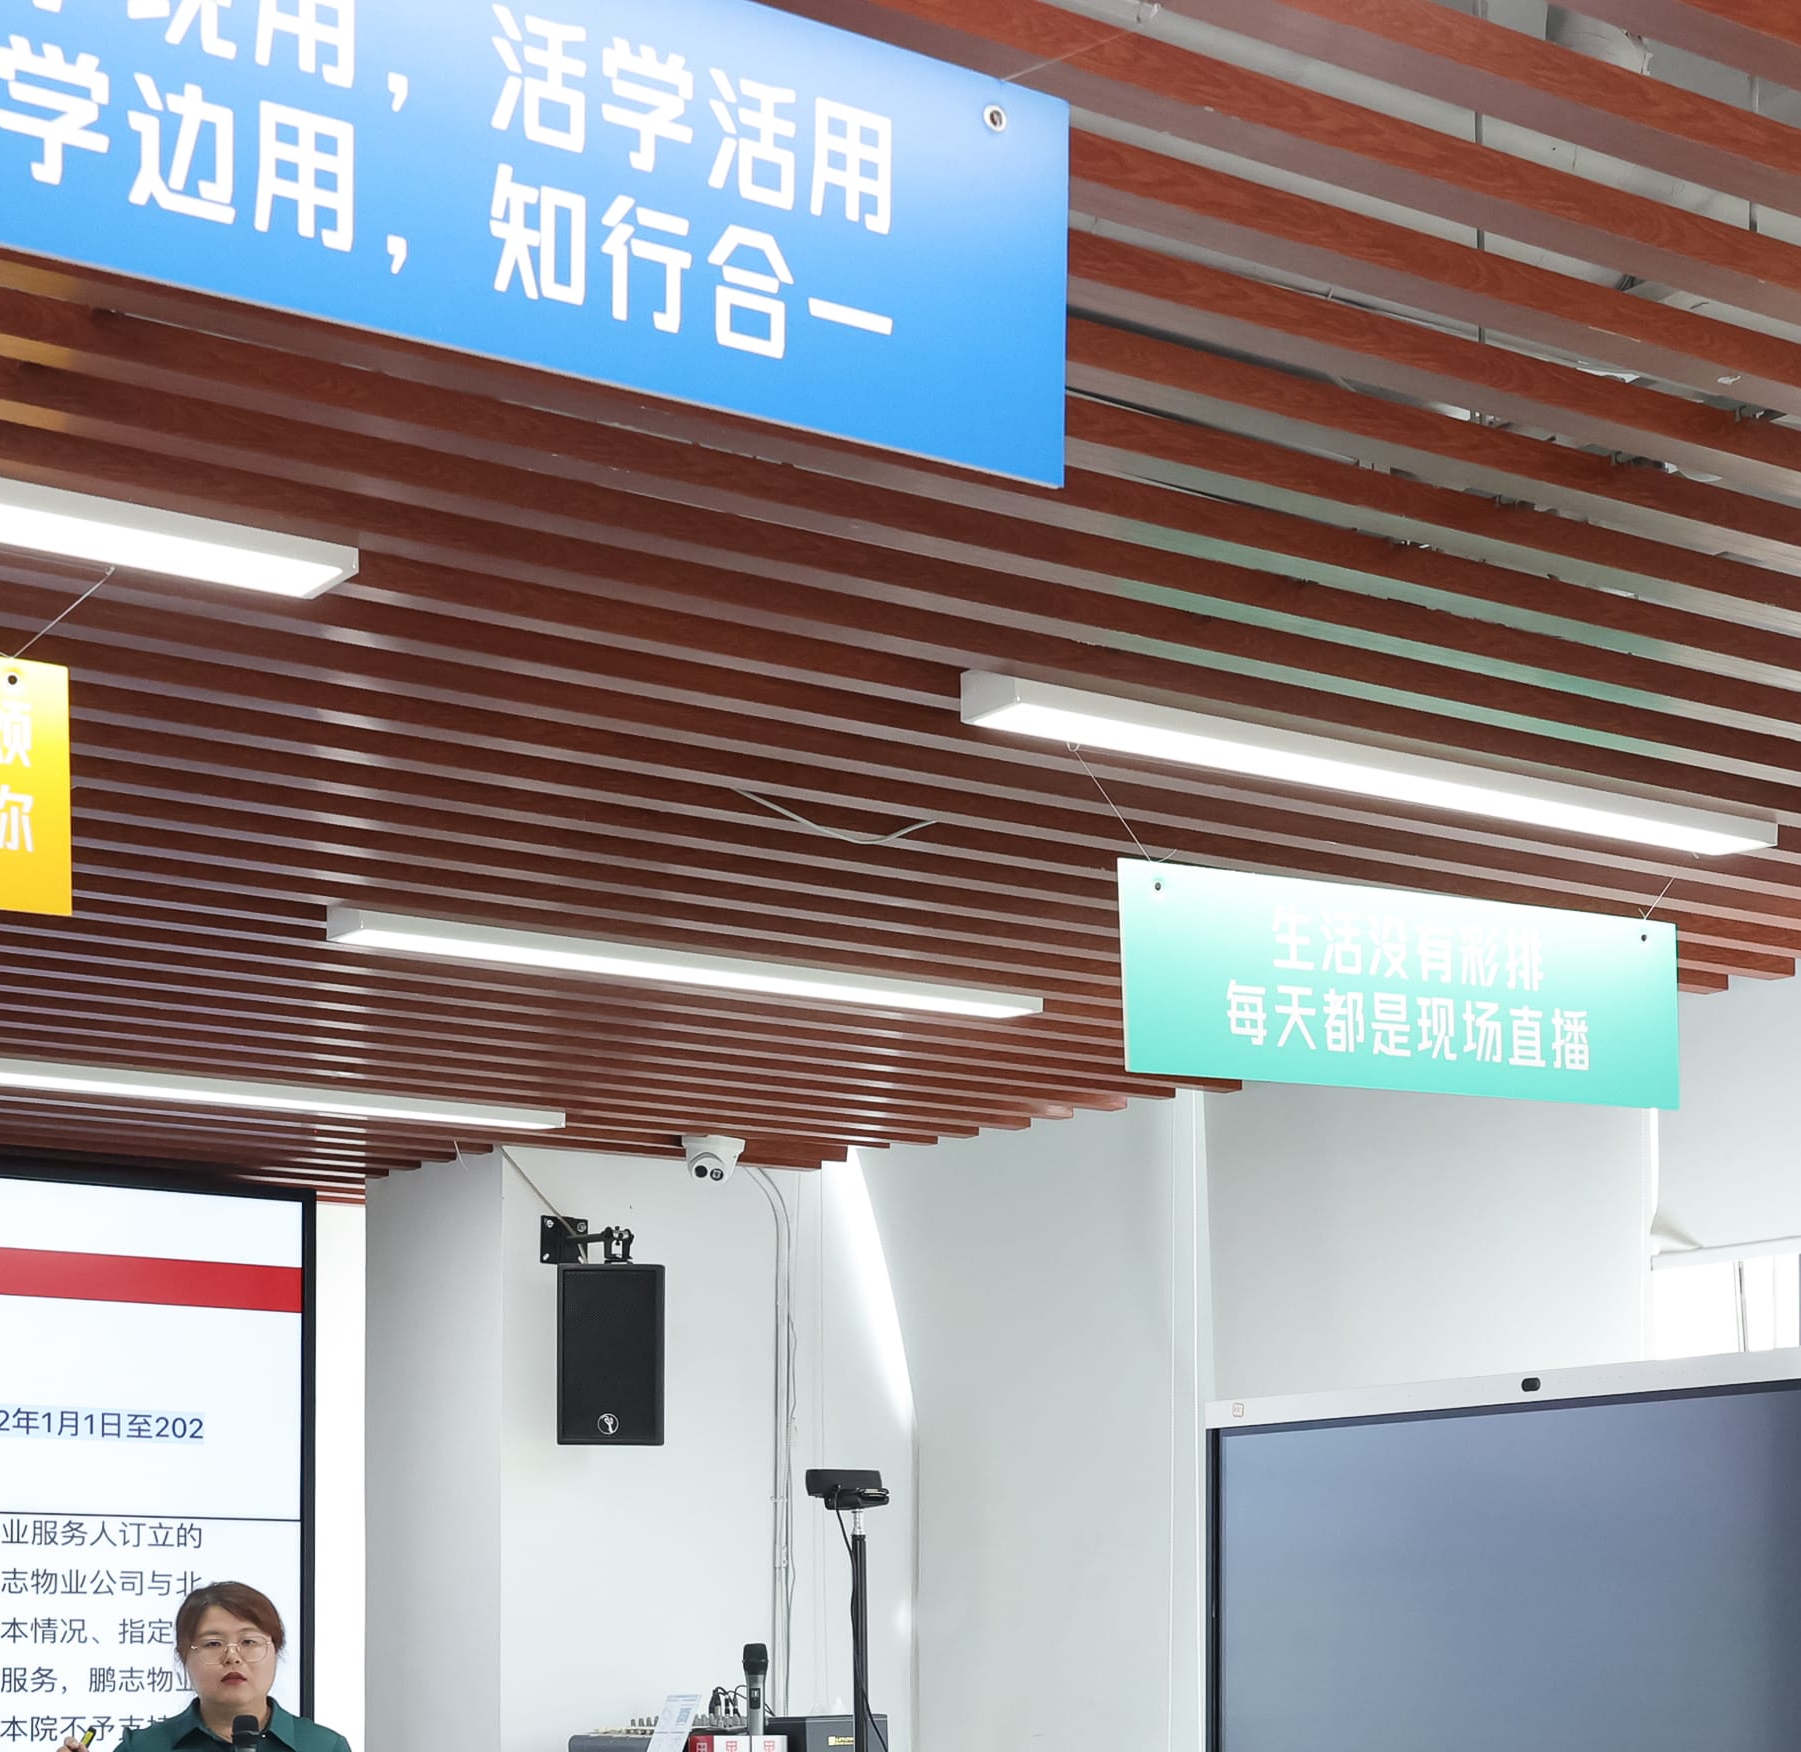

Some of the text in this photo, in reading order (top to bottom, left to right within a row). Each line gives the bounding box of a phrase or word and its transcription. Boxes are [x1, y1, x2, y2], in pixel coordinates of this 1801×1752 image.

[32, 0, 893, 235] 用，活学活用
[1271, 904, 1544, 992] 生活没有彩排
[1226, 979, 1590, 1072] 每天都是现场直播
